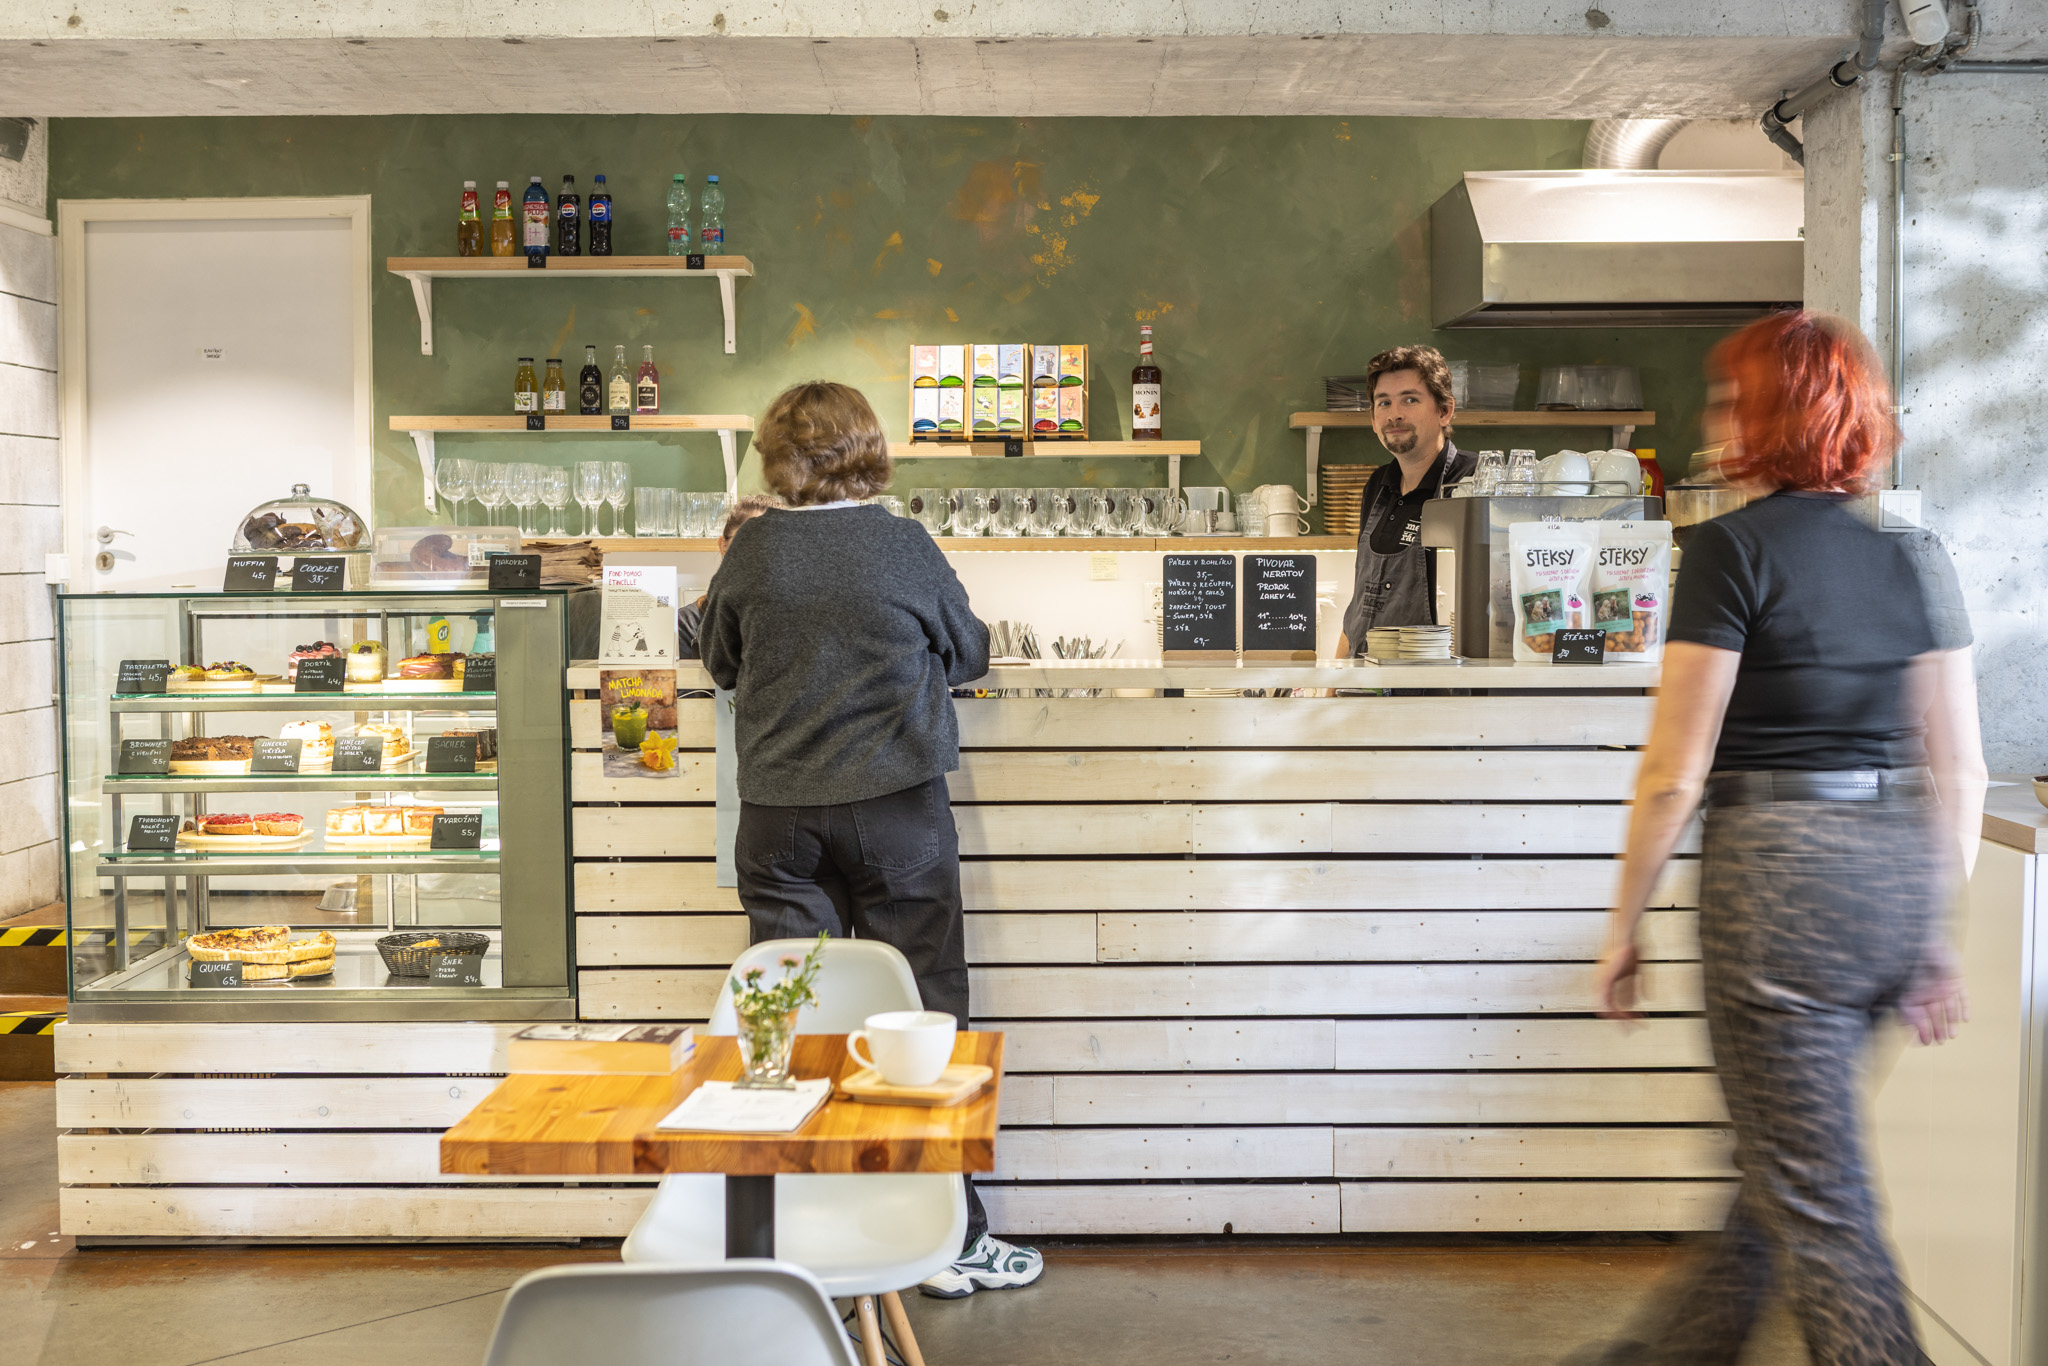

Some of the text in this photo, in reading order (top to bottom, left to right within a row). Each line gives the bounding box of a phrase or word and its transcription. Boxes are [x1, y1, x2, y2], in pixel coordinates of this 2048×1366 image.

[1526, 548, 1574, 567] ŠTĚKSY
[1599, 547, 1648, 566] ŠTĚKSY
[494, 558, 528, 566] MAKOVKA
[1168, 558, 1191, 566] PÁREK
[1201, 557, 1233, 566] ROHLÍKU
[1256, 557, 1295, 568] PIVOVAR
[299, 563, 339, 573] COOKIES
[1196, 571, 1213, 580] 35,-
[1262, 569, 1305, 578] NERATOV
[1256, 582, 1290, 591] PROROK
[1174, 623, 1190, 631] SÝR
[438, 626, 448, 640] Cif
[1562, 632, 1594, 641] ŠTĚKSY
[608, 676, 643, 690] MATCHA
[129, 741, 168, 749] BROWNIES
[434, 740, 466, 749] SACHER
[441, 956, 463, 966] ŠNEK
[199, 963, 234, 973] QUICHE
